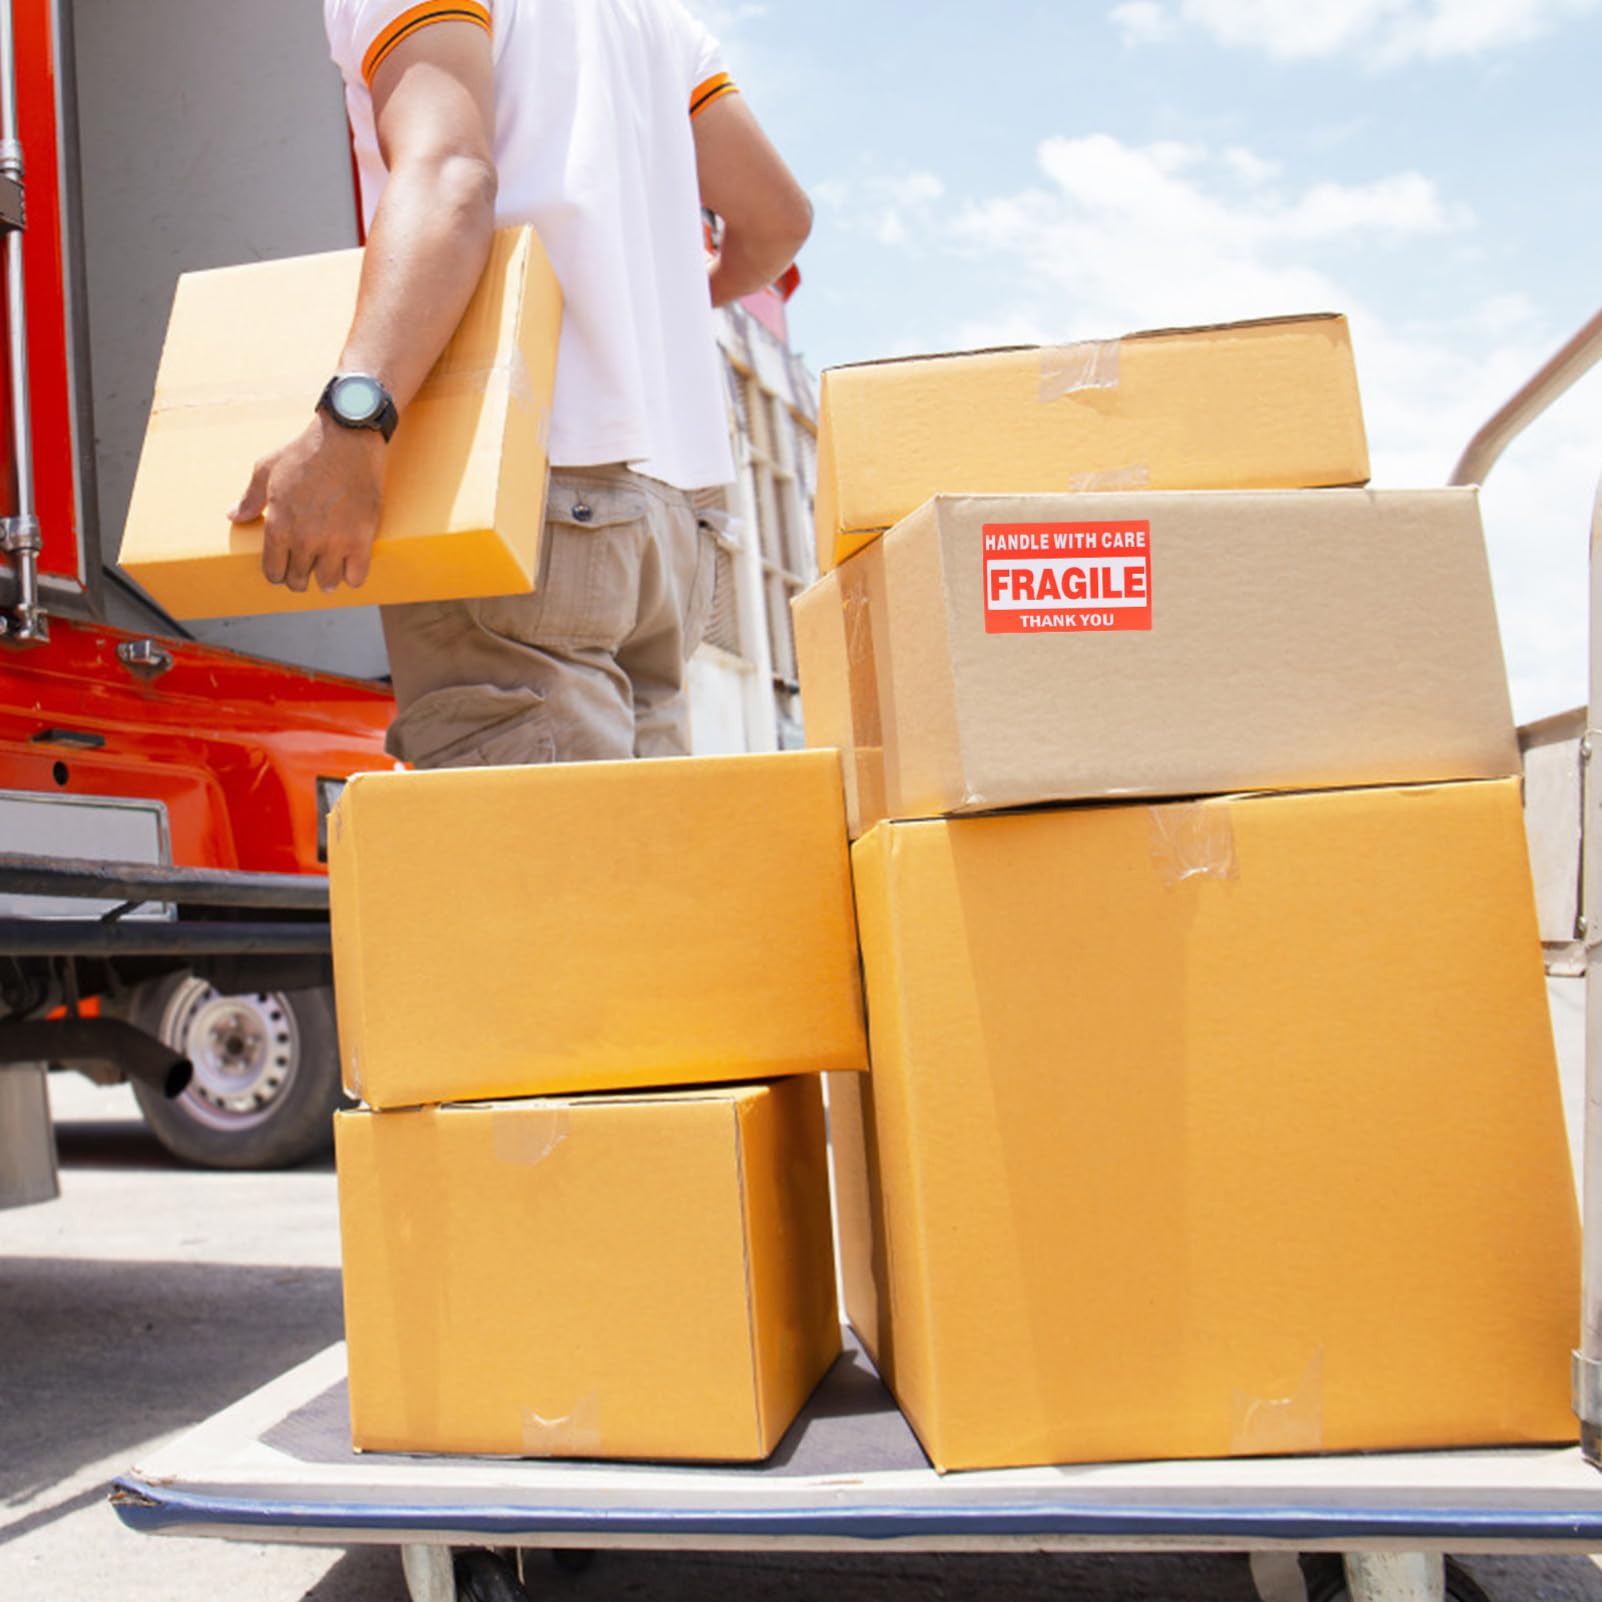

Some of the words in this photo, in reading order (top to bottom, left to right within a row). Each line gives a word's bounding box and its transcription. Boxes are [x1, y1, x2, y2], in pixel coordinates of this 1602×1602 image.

[985, 533, 1049, 551] HANDLE
[1053, 532, 1097, 549] WITH
[1101, 531, 1146, 548] CARE
[990, 566, 1146, 601] FRAGILE
[1020, 614, 1076, 628] THANK
[1079, 613, 1114, 627] YOU
